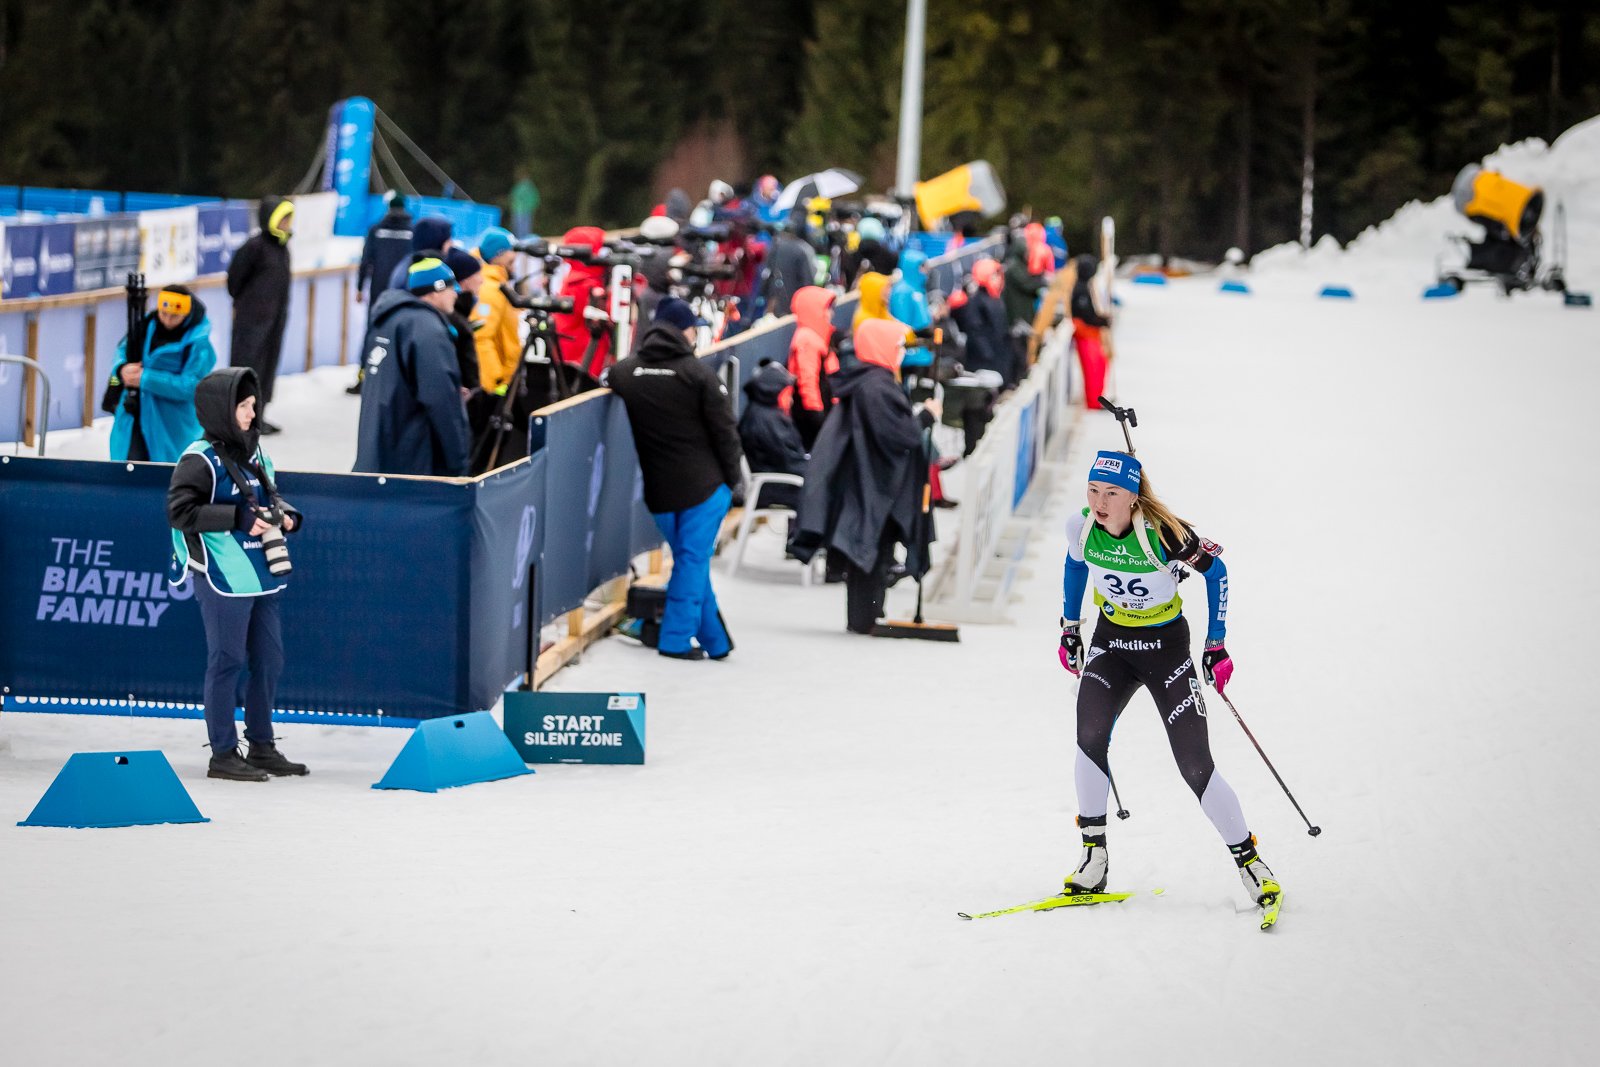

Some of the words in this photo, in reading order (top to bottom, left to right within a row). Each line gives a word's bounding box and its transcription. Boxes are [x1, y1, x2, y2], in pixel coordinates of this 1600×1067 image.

[51, 537, 114, 566] THE
[1088, 548, 1127, 565] Szklarska
[42, 566, 196, 601] BIATHLO
[1103, 574, 1149, 597] 36
[36, 595, 170, 627] FAMILY
[1217, 575, 1228, 621] EESTI
[1164, 658, 1193, 688] ALEXE
[542, 715, 605, 732] START
[524, 732, 579, 746] SILENT
[580, 733, 623, 747] ZONE
[1071, 895, 1094, 903] FISCHER
